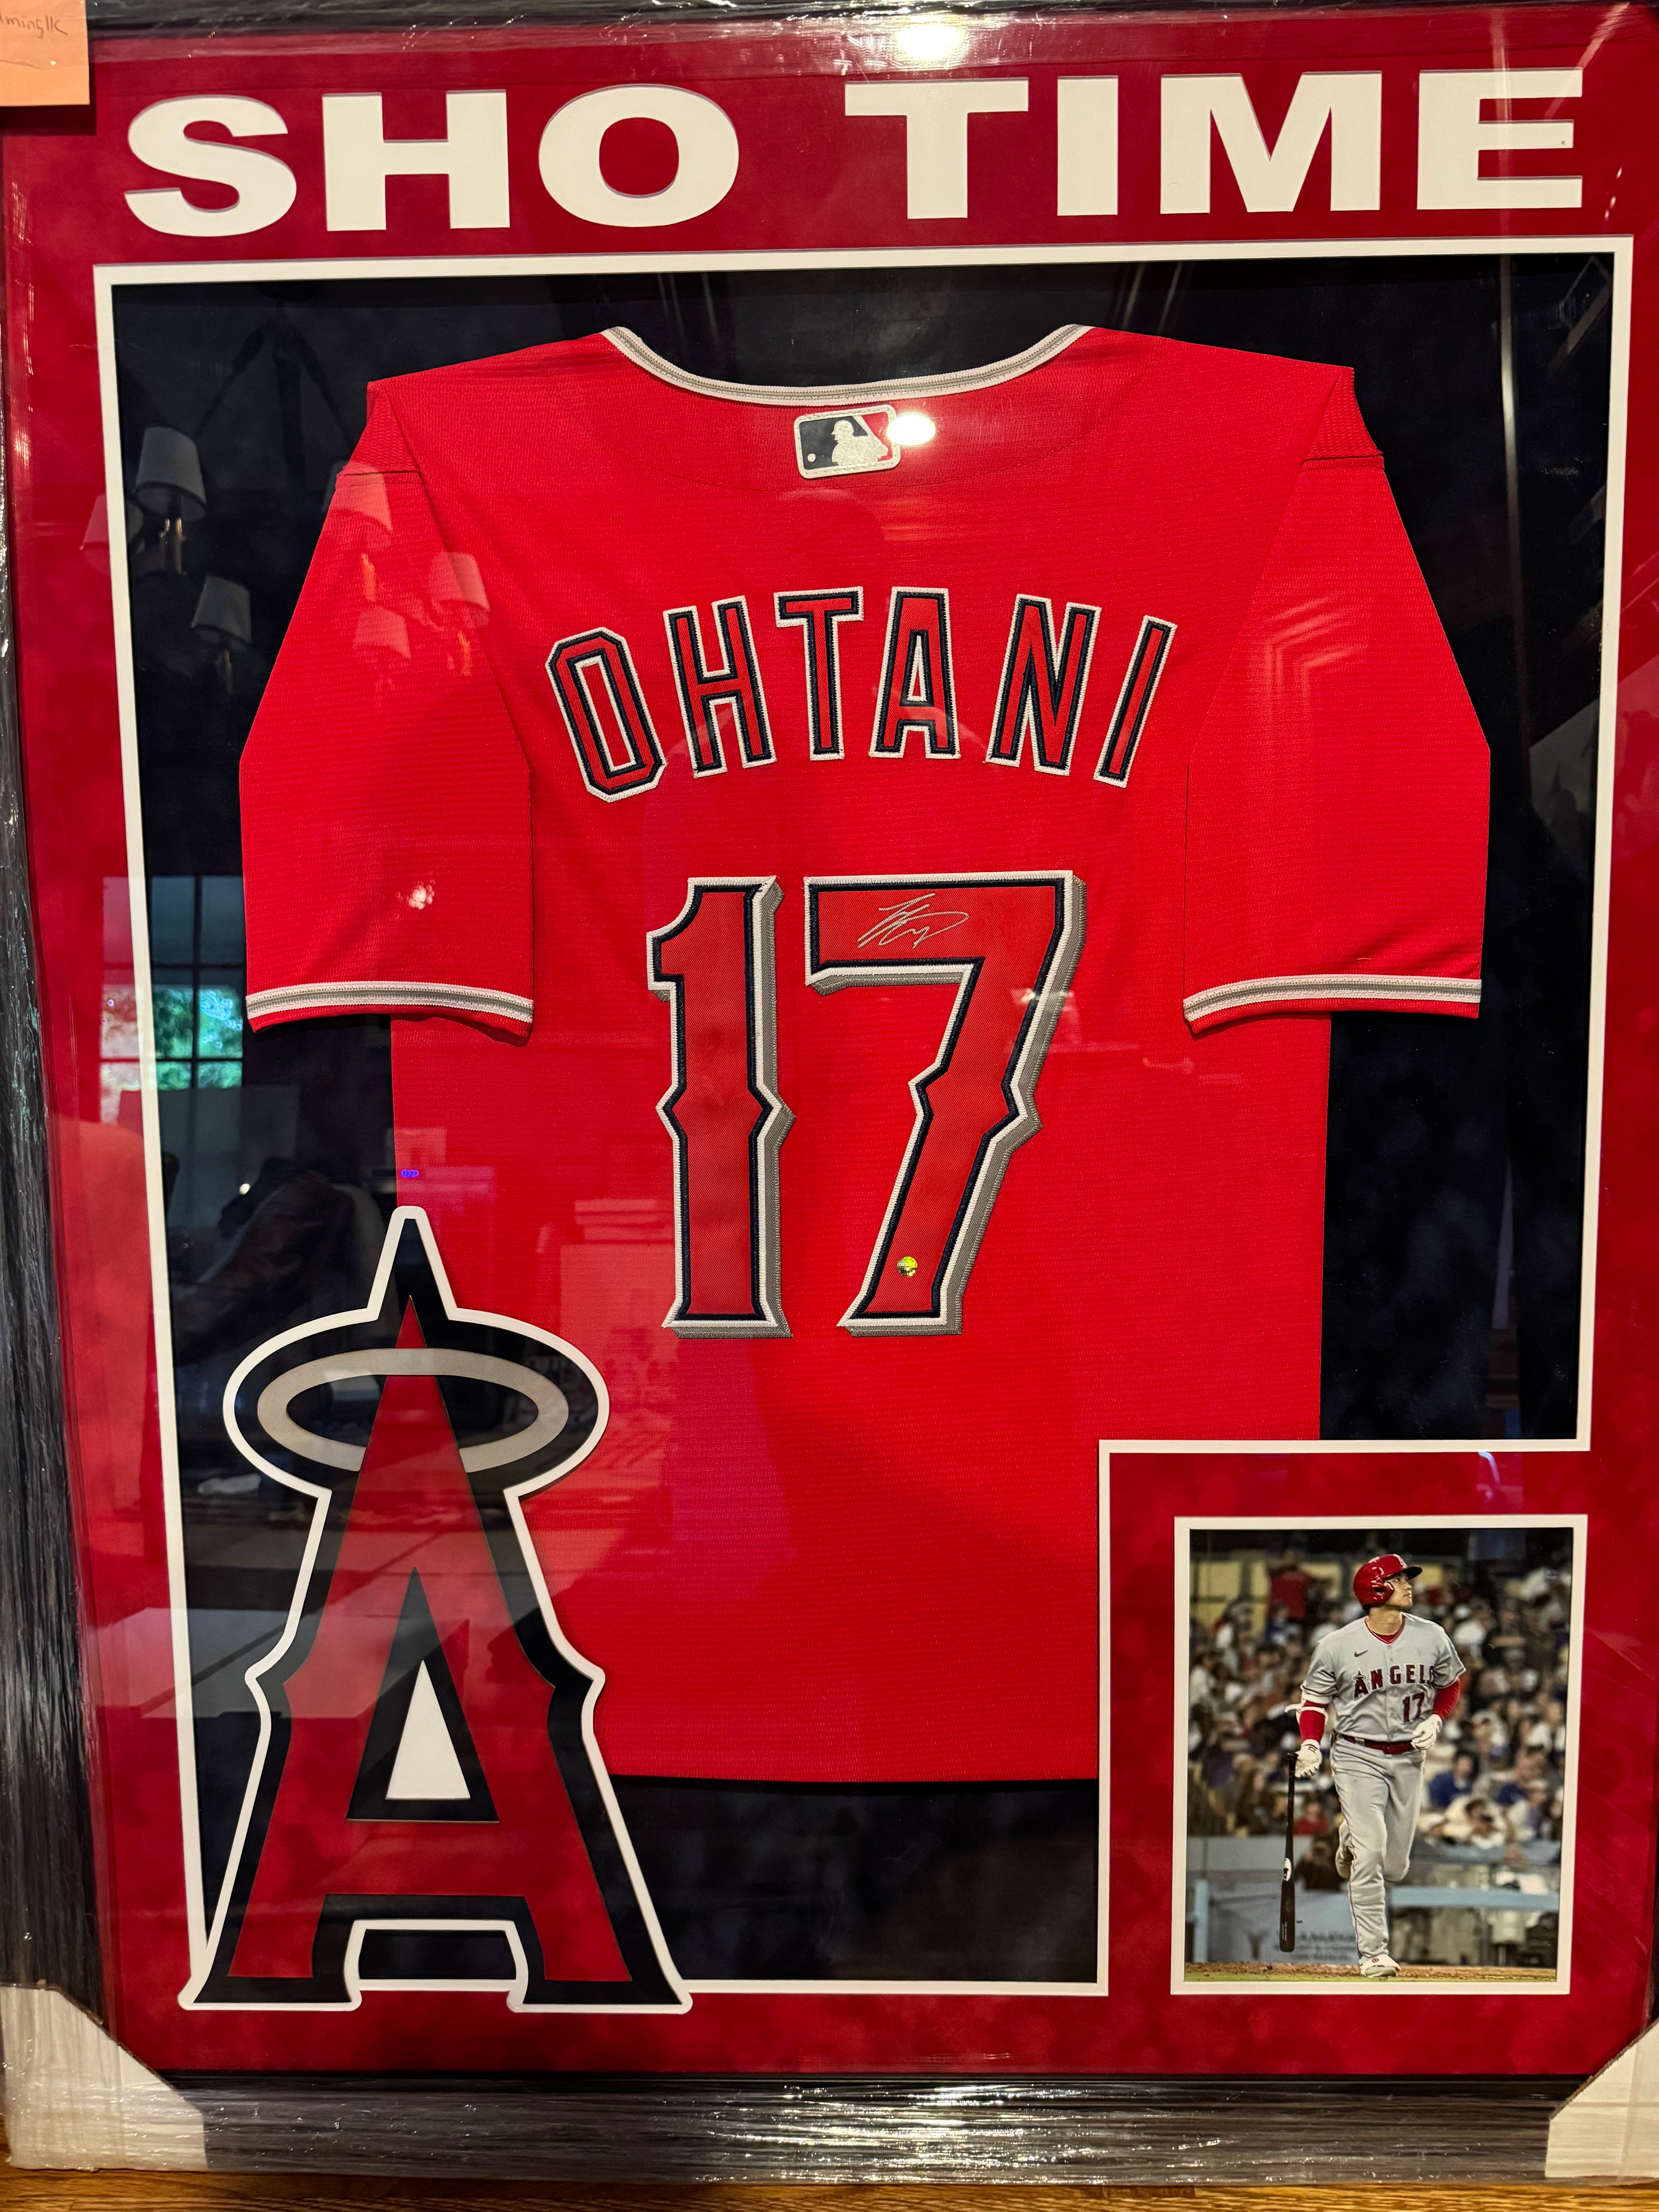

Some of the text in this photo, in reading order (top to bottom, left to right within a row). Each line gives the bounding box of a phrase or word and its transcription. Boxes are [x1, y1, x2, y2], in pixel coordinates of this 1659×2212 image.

[124, 68, 1583, 237] SHO TIME
[545, 586, 1177, 802] OHTANI
[646, 870, 1087, 1338] 17
[178, 1205, 693, 2014] A
[1402, 1691, 1425, 1723] 17
